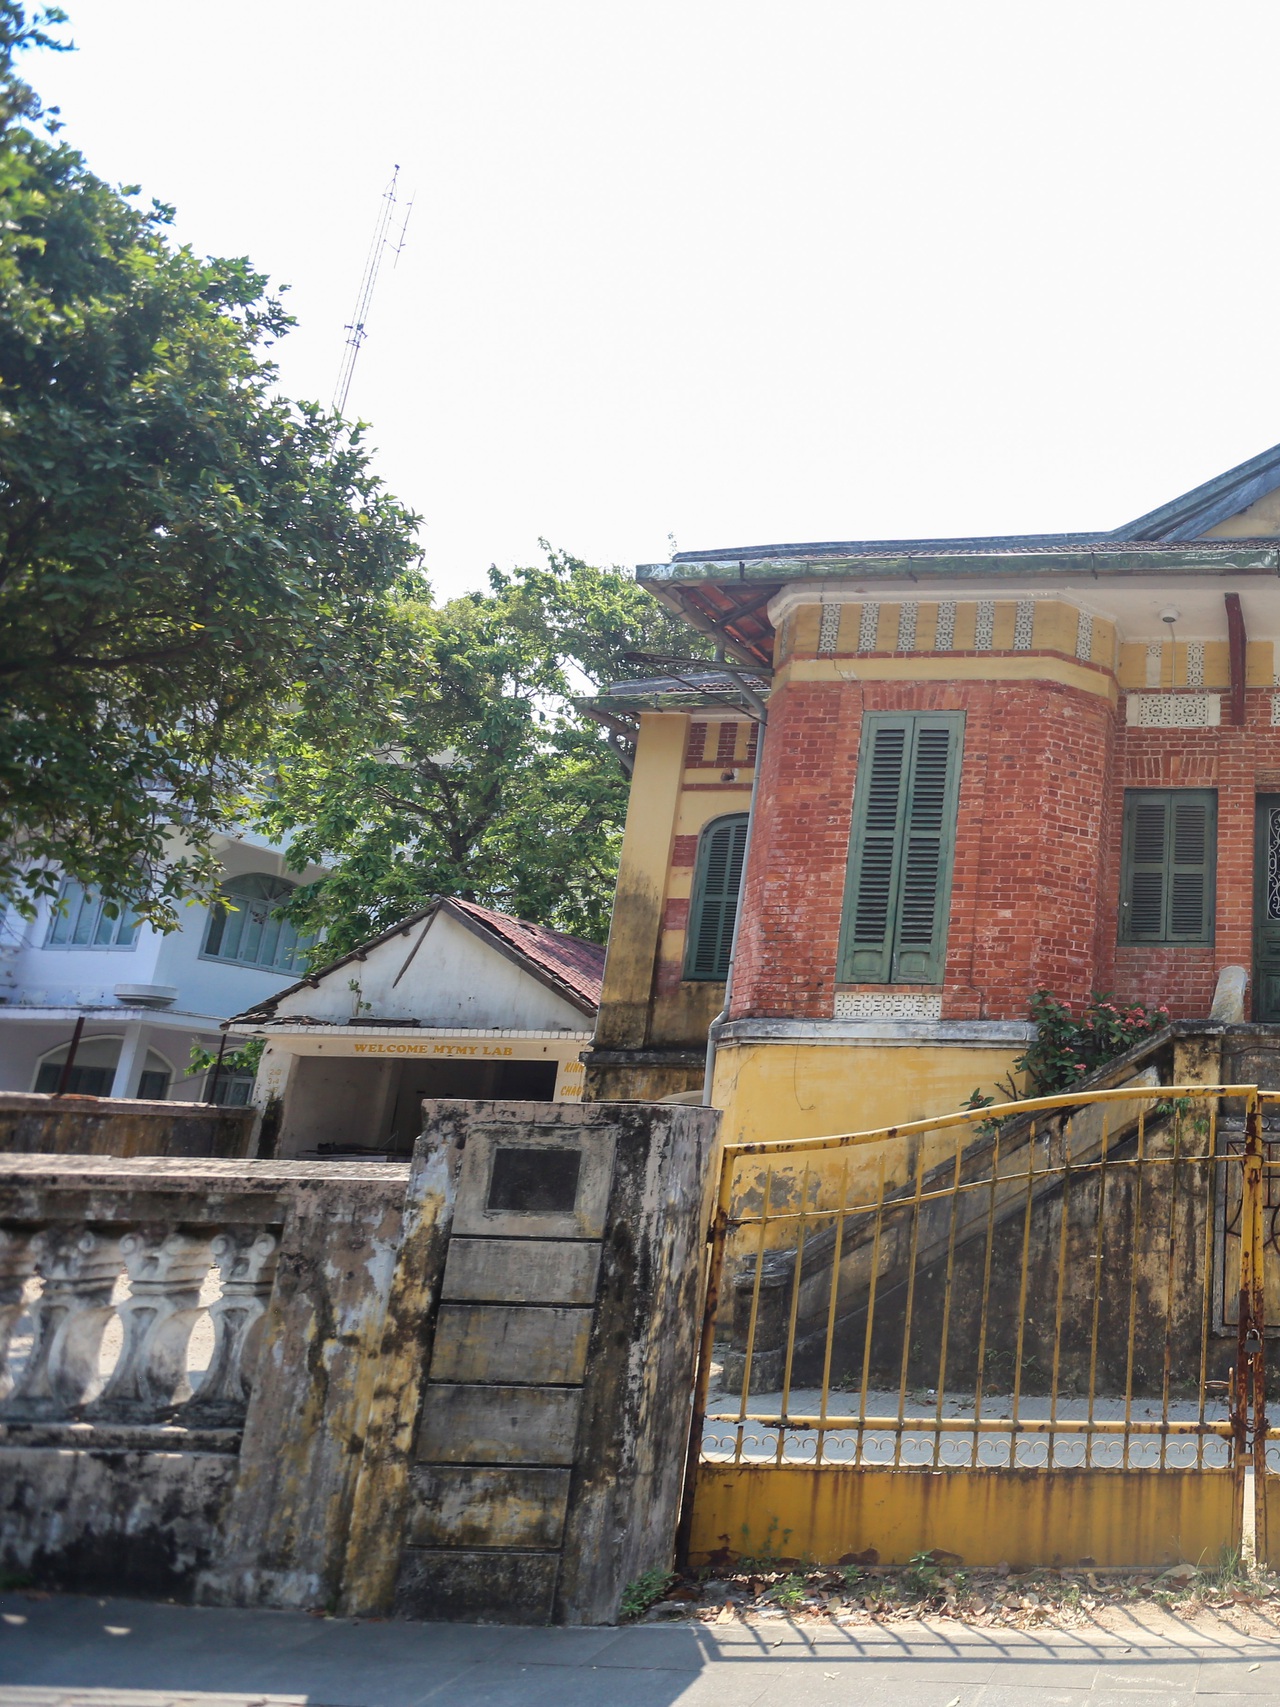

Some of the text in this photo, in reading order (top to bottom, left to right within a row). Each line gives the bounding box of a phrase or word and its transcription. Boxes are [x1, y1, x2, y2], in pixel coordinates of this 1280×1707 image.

[354, 1043, 513, 1056] WELCOME MYMY LAB
